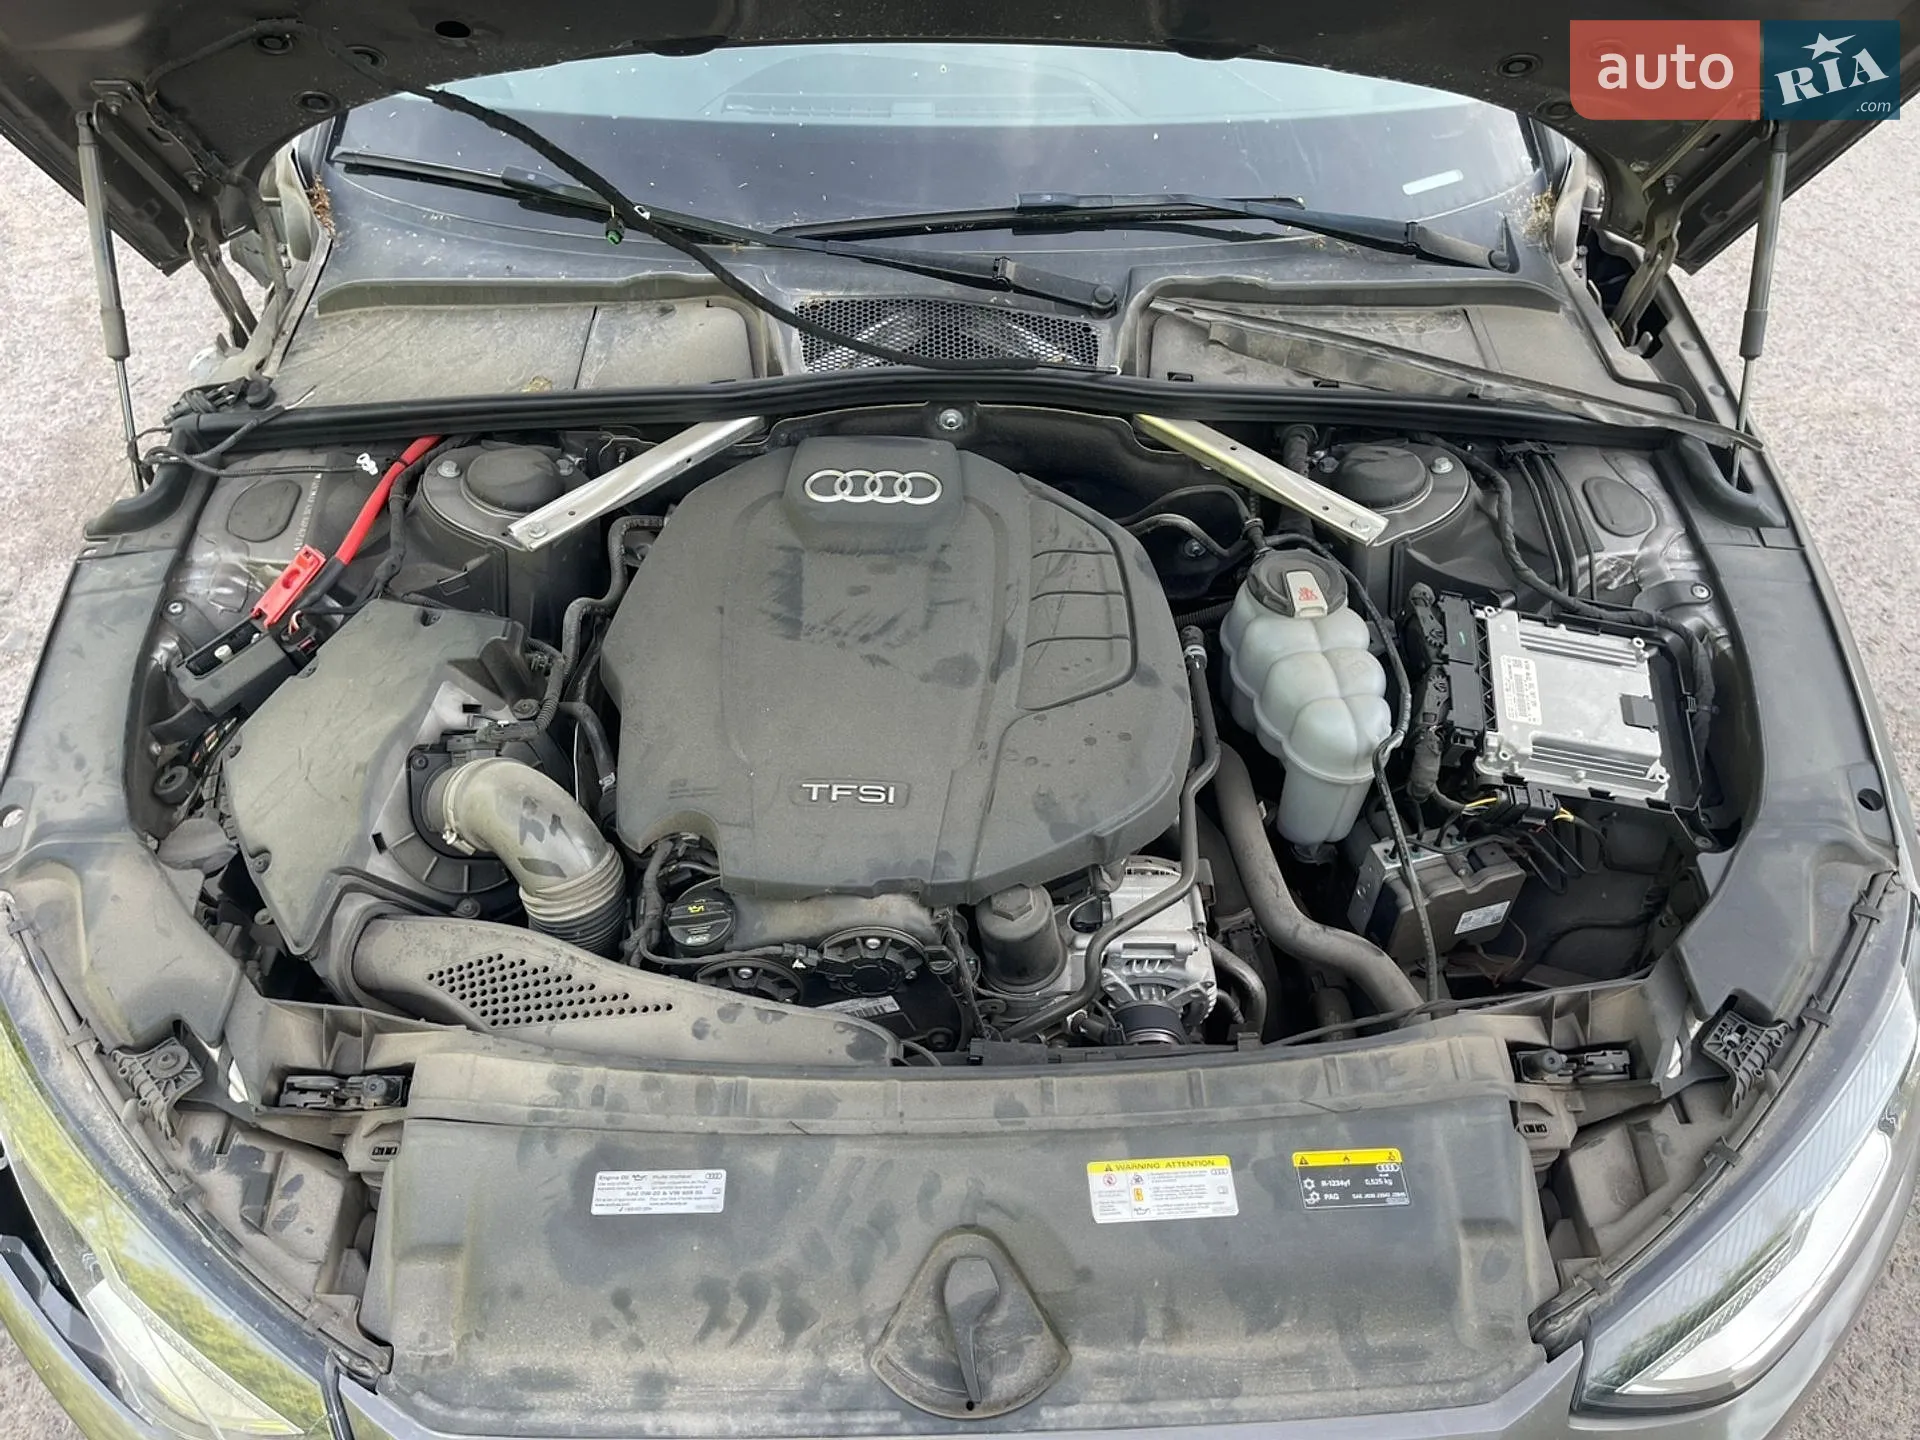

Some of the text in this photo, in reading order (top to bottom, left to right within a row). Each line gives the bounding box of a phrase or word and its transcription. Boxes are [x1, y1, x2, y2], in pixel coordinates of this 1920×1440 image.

[802, 783, 895, 804] TFSI
[1115, 1159, 1215, 1171] WARNING ATTENTION
